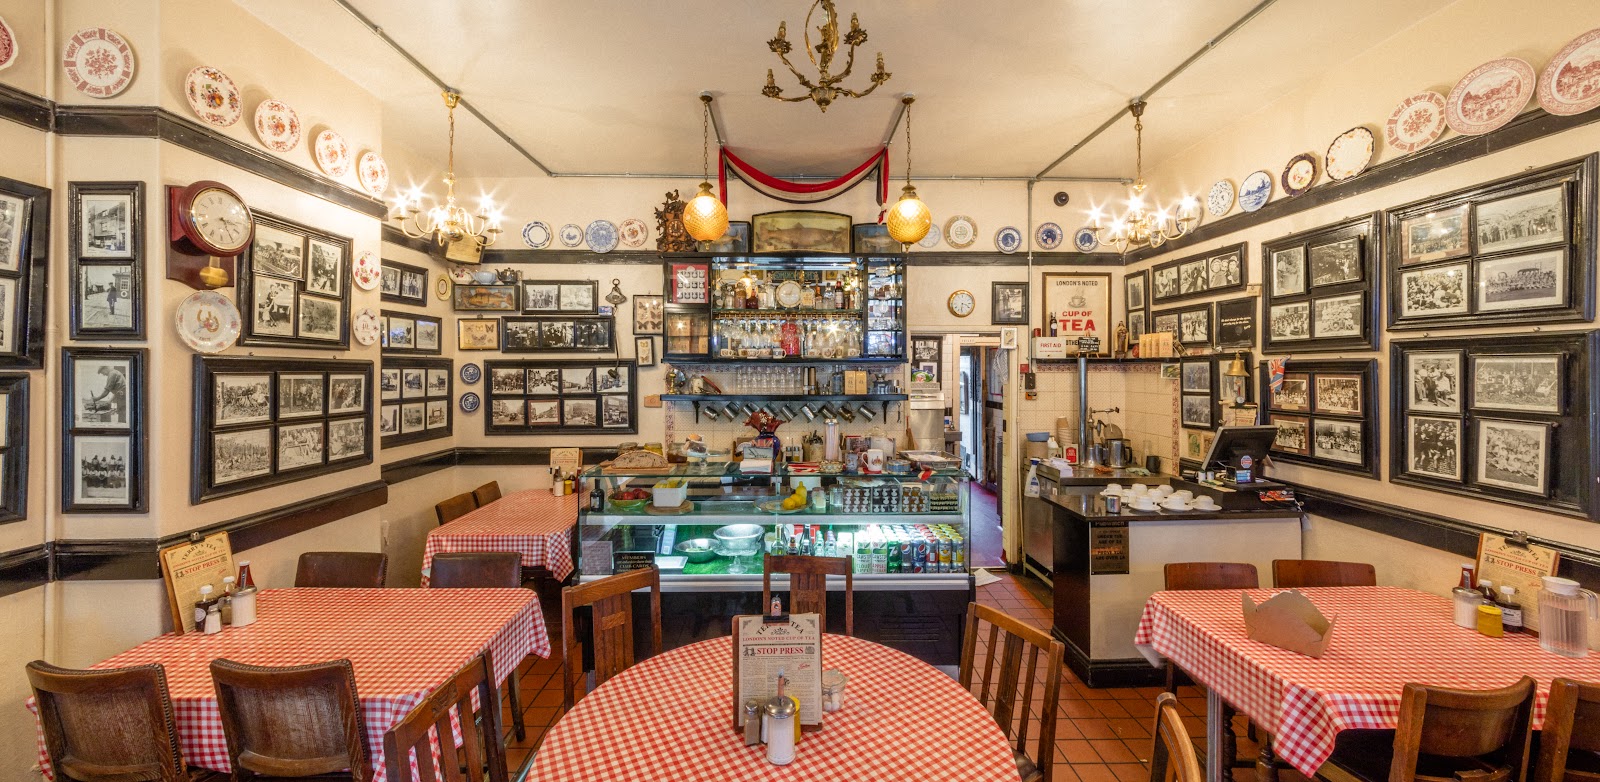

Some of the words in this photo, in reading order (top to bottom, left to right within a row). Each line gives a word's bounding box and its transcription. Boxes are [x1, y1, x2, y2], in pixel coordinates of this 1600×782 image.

[1059, 319, 1096, 331] TEA
[184, 565, 202, 575] STOP
[202, 559, 220, 568] PRESS
[1496, 559, 1514, 568] STOP
[1515, 564, 1536, 576] PRESS
[791, 620, 804, 634] TEA
